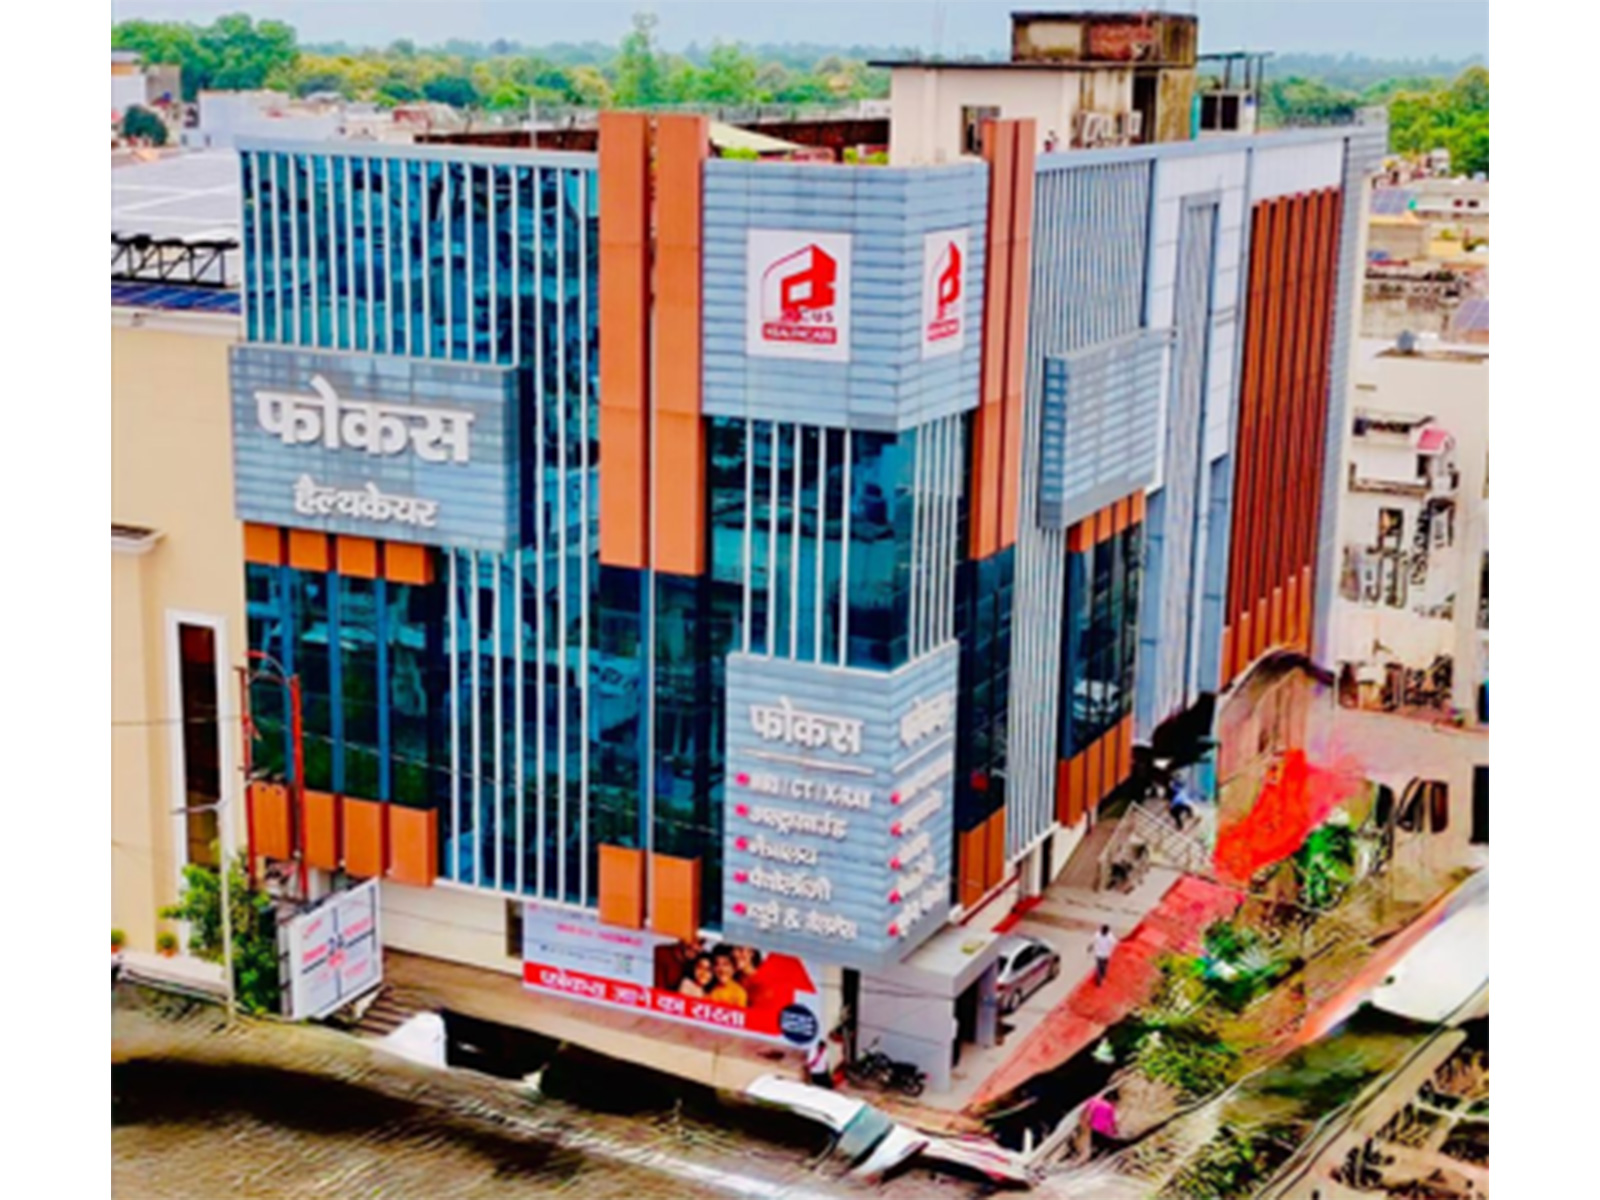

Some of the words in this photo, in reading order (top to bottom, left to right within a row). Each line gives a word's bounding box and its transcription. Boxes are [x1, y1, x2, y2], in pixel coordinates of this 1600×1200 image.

[254, 375, 474, 464] फोकस
[749, 696, 863, 754] फोकस
[791, 779, 815, 799] CT
